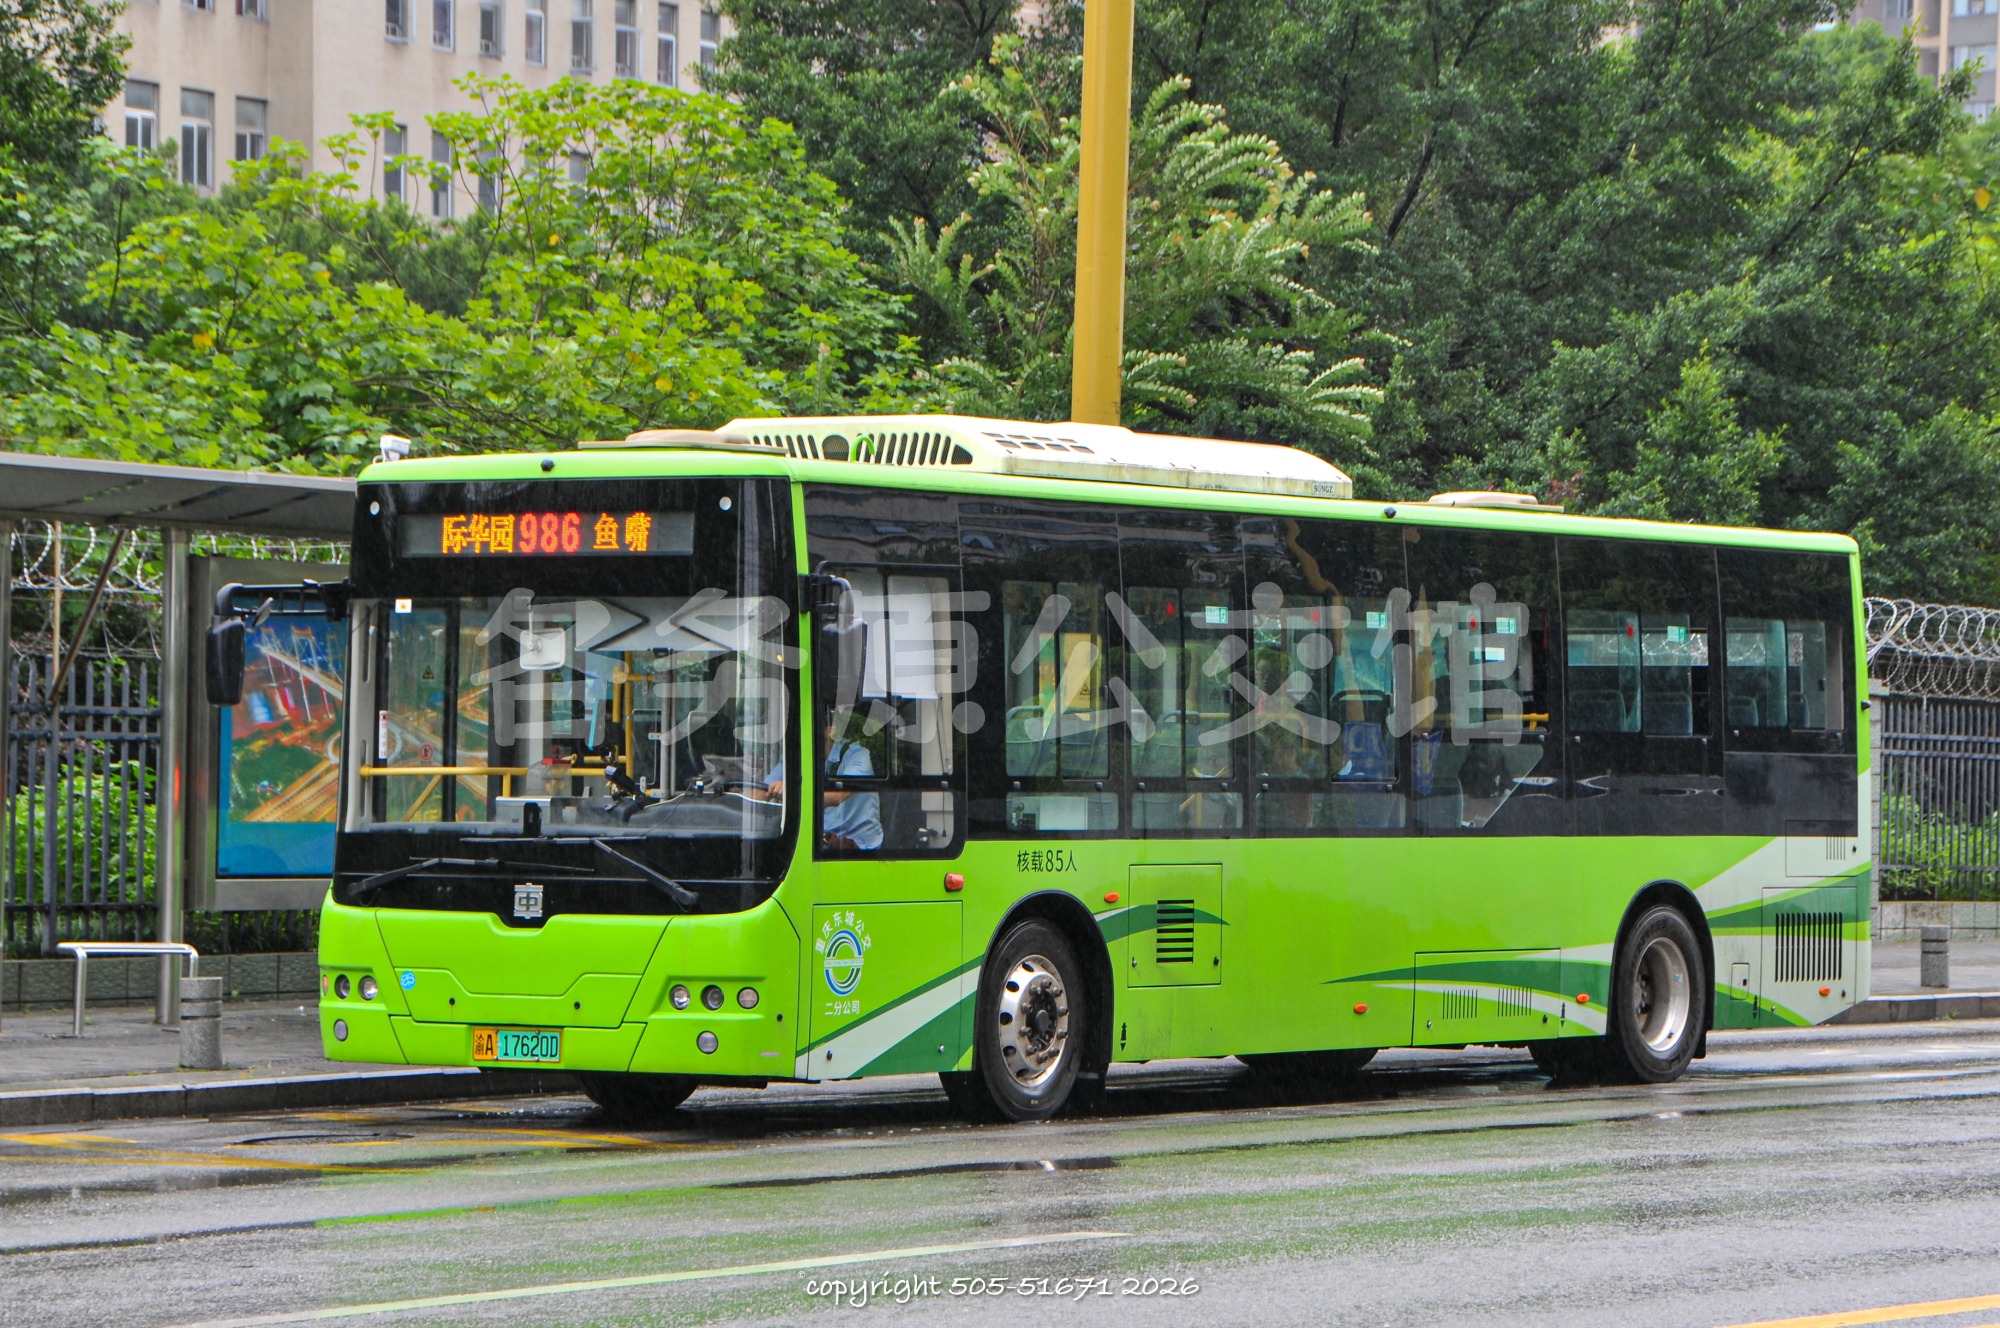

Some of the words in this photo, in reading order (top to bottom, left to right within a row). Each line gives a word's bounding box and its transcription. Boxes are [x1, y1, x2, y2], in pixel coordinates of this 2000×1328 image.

[442, 514, 515, 553] 际华园
[519, 512, 581, 553] 986
[1017, 850, 1077, 872] 核载85人
[825, 1000, 860, 1016] 二分公司
